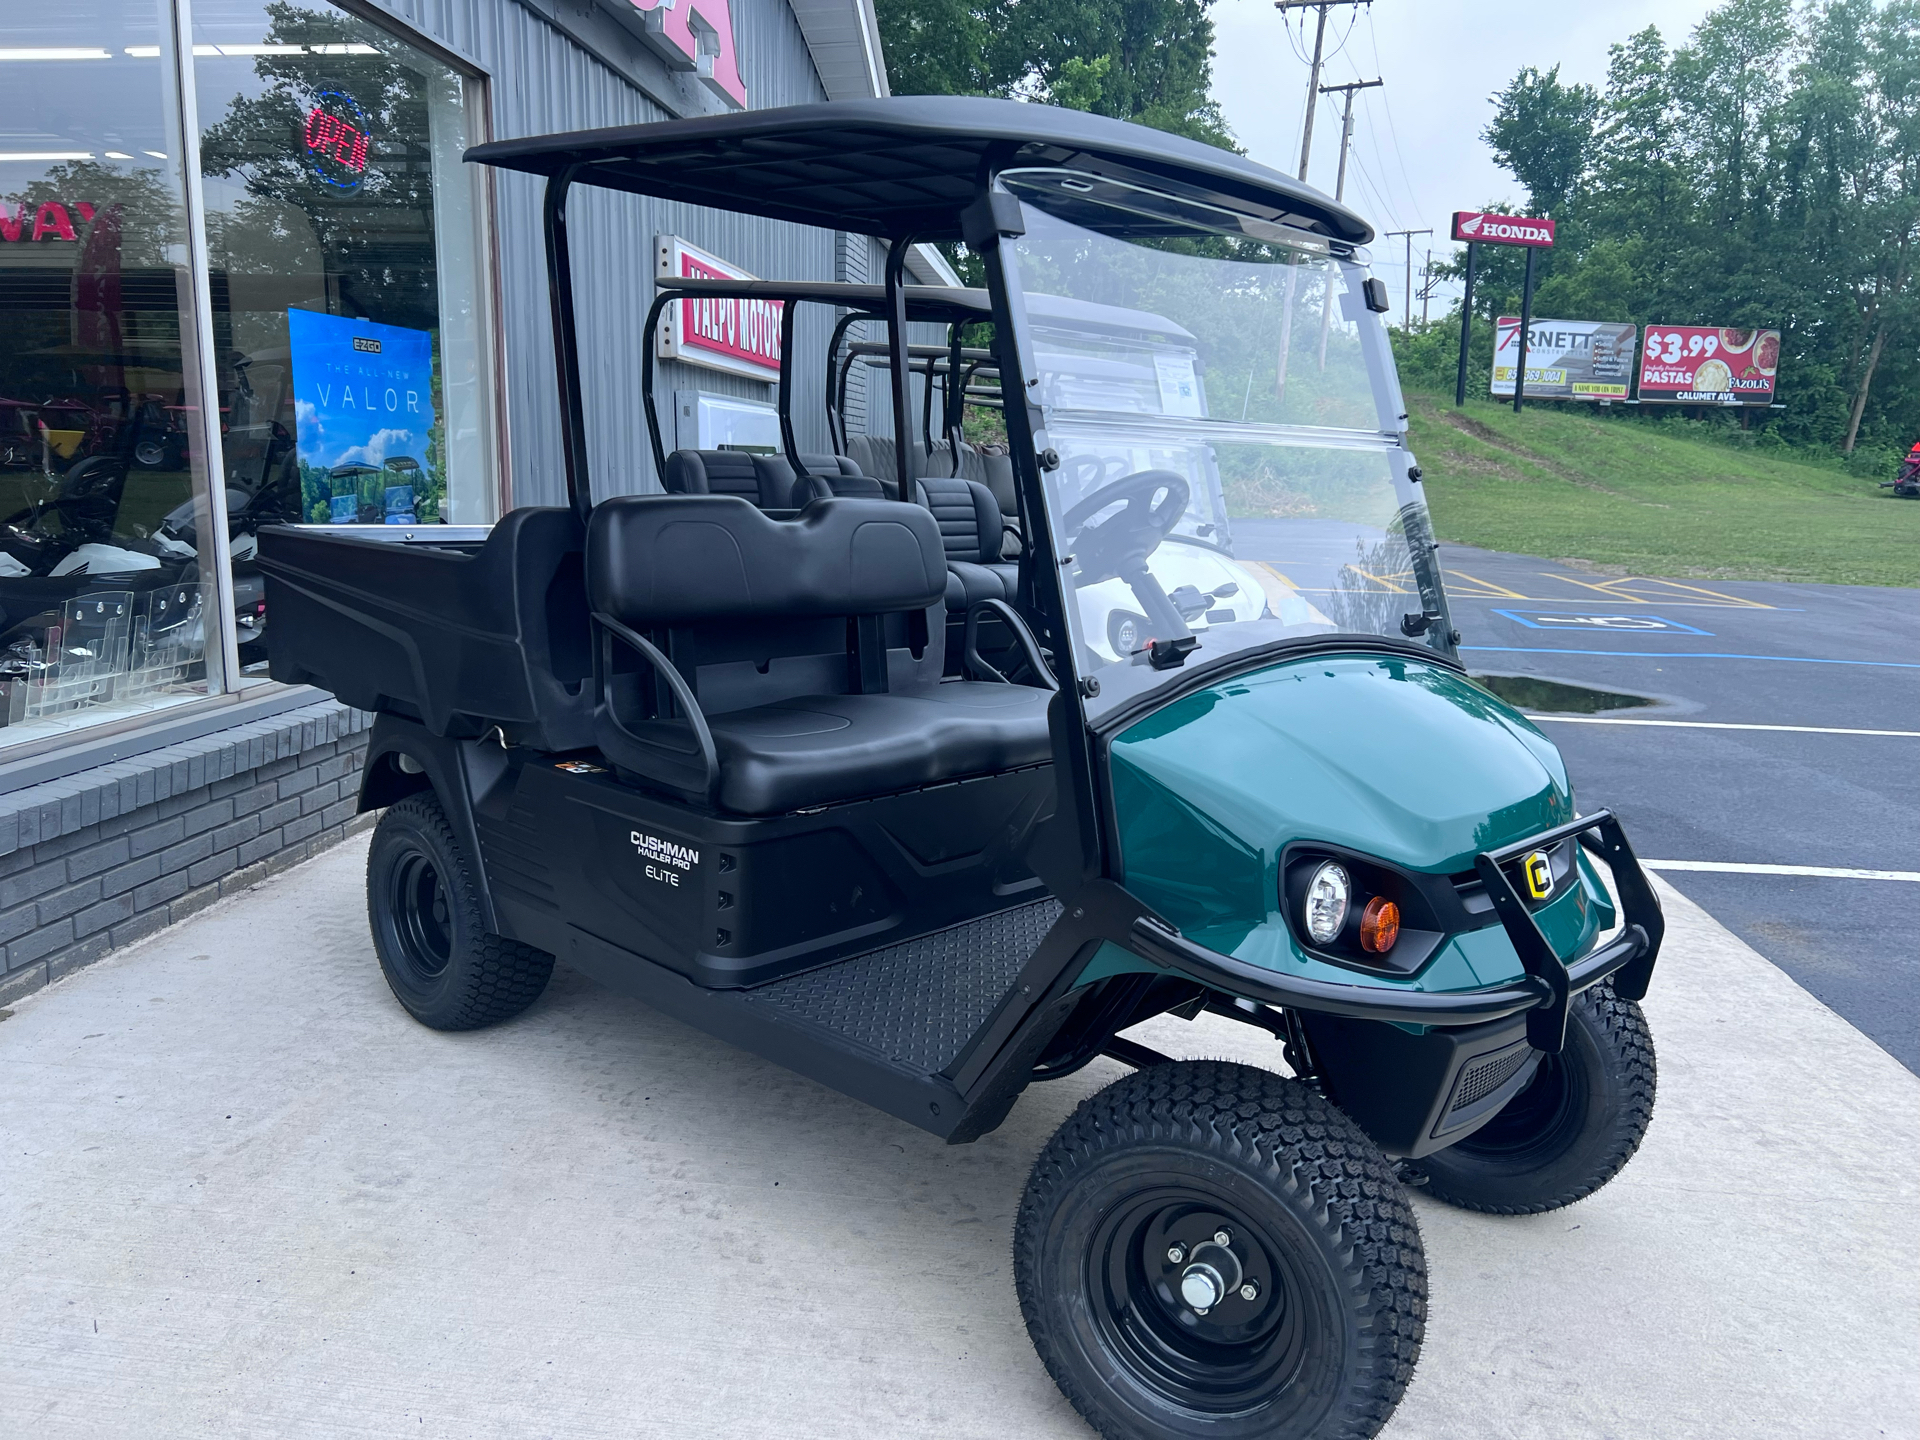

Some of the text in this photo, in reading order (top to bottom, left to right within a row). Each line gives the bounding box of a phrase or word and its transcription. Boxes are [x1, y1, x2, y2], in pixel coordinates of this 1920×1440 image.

[306, 108, 369, 172] OPEN
[1481, 223, 1552, 242] HONDA
[690, 265, 735, 347] VALPO
[1531, 348, 1589, 356] CONSTRUCTION
[1646, 332, 1718, 364] $3.99
[326, 363, 410, 380] THE ALL-NEW
[1643, 371, 1693, 384] PASTAS
[1728, 377, 1770, 390] FAZOLI'S
[316, 383, 419, 414] VALOR
[1676, 391, 1737, 401] CALUMET AVE.
[630, 830, 699, 865] CUSHMAN
[637, 846, 691, 871] HAULER PRO
